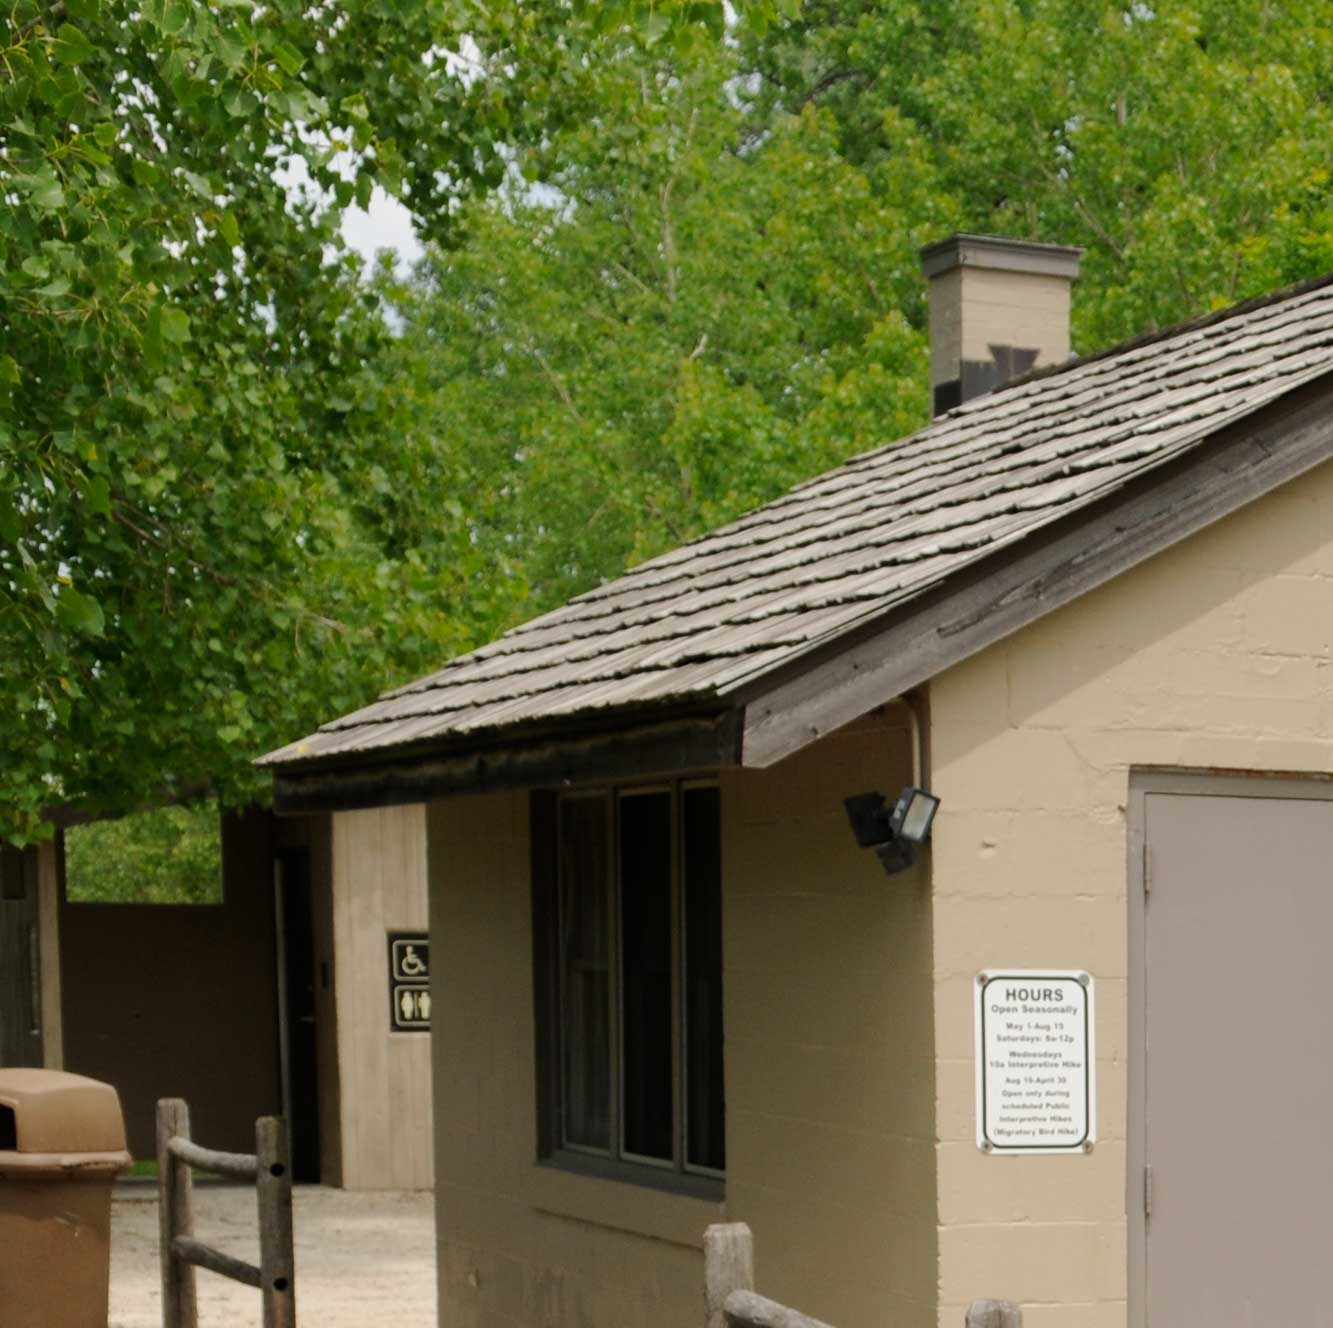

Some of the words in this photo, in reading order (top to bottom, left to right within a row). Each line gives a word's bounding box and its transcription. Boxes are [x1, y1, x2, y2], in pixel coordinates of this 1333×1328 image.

[1006, 988, 1064, 1002] HOURS
[992, 1005, 1018, 1015] Open
[1022, 1005, 1078, 1015] Seasonally
[1006, 1022, 1023, 1031] May
[1009, 1051, 1062, 1059] Wednesdays
[1002, 1090, 1022, 1098] Open
